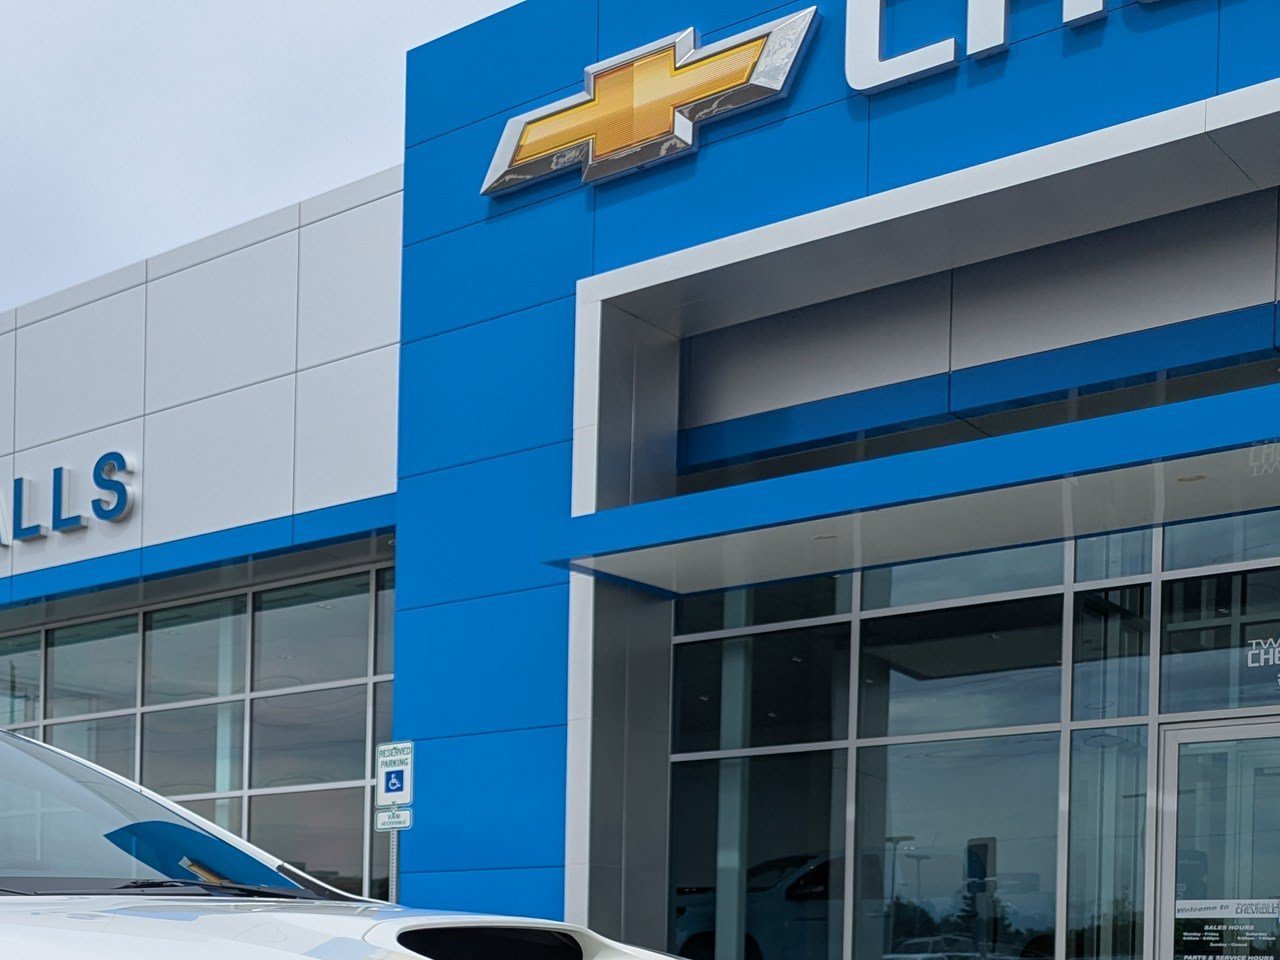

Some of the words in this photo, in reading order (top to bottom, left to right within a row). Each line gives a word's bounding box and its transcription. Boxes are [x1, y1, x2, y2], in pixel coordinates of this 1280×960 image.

[379, 747, 410, 757] RESERVED
[380, 758, 409, 768] PARKING
[1177, 905, 1217, 914] Welcome
